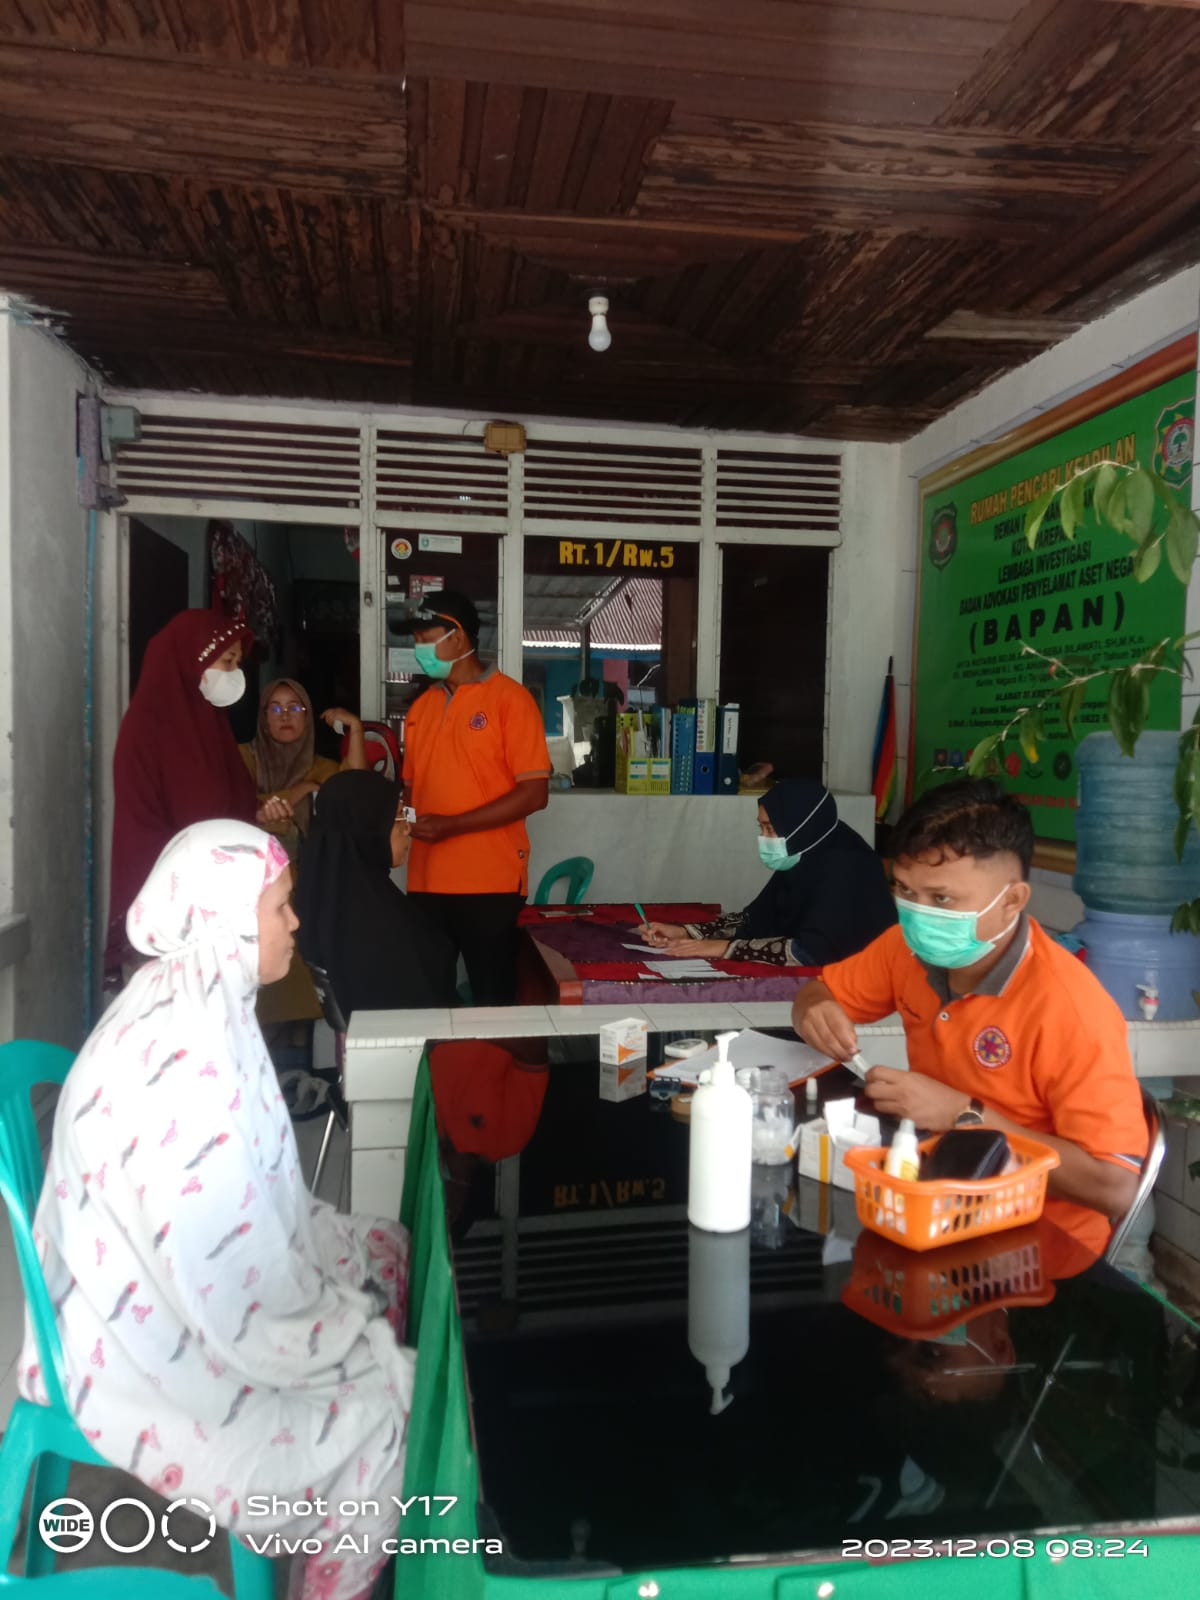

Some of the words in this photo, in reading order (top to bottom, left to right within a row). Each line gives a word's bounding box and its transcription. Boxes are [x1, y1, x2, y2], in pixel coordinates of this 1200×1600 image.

[970, 486, 1008, 525] RUMAH
[1010, 466, 1060, 509] PENCARI
[983, 585, 1020, 610] ADVOKASI
[1021, 569, 1076, 601] PENYELAMAT
[1079, 561, 1104, 587] ASET
[1106, 555, 1134, 583] NEGA
[998, 555, 1034, 585] LEMBAGA
[1036, 540, 1092, 574] INVESTIGASI
